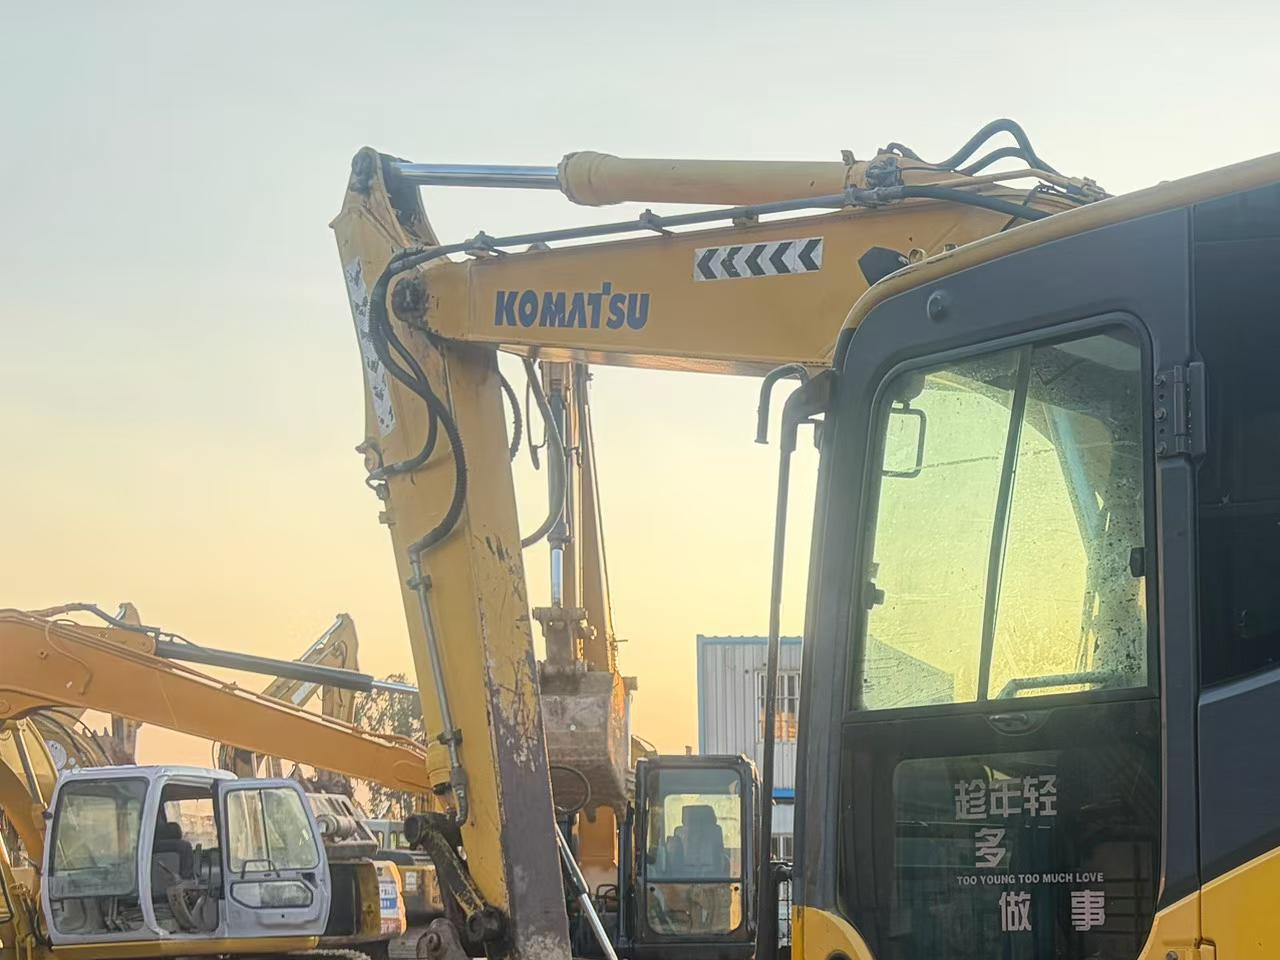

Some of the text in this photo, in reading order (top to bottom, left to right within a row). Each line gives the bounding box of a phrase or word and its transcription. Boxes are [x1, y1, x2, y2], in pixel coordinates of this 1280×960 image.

[494, 281, 651, 330] KOMATSU
[955, 774, 1057, 820] 趁年轻
[975, 827, 1006, 868] 多
[957, 872, 1104, 885] TOO YOUNG TOO MUCH LOVE
[999, 890, 1105, 931] 做 事
